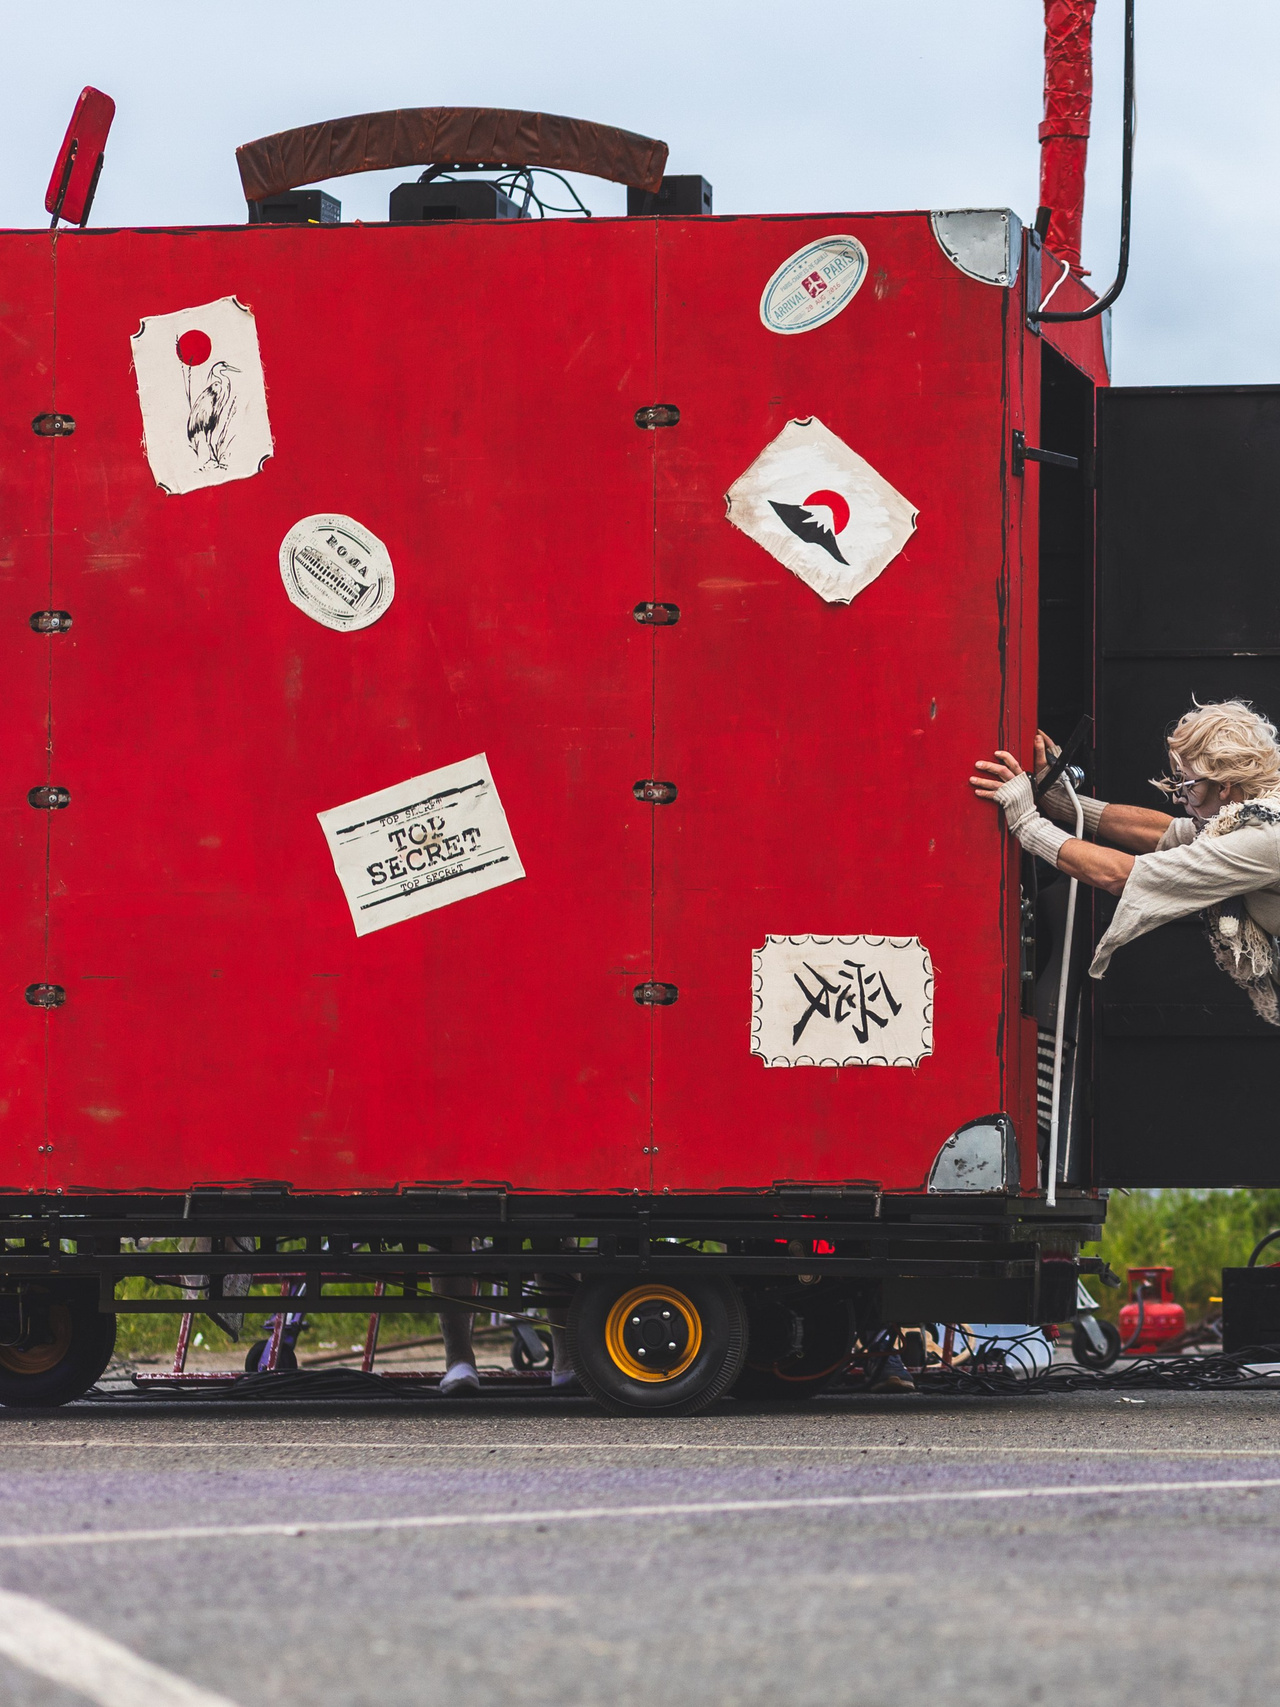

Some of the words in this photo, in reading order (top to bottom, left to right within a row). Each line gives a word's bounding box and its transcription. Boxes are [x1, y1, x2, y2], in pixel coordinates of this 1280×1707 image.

[774, 291, 807, 320] ARRIVAL
[823, 251, 855, 280] PARIS
[815, 295, 827, 306] AUG
[827, 282, 841, 295] 2016
[326, 534, 368, 578] ROMA
[379, 815, 400, 827] TOP
[387, 815, 446, 852] TOP
[366, 827, 482, 886] SECRET
[400, 879, 420, 891] TOP
[426, 863, 465, 883] SECRET
